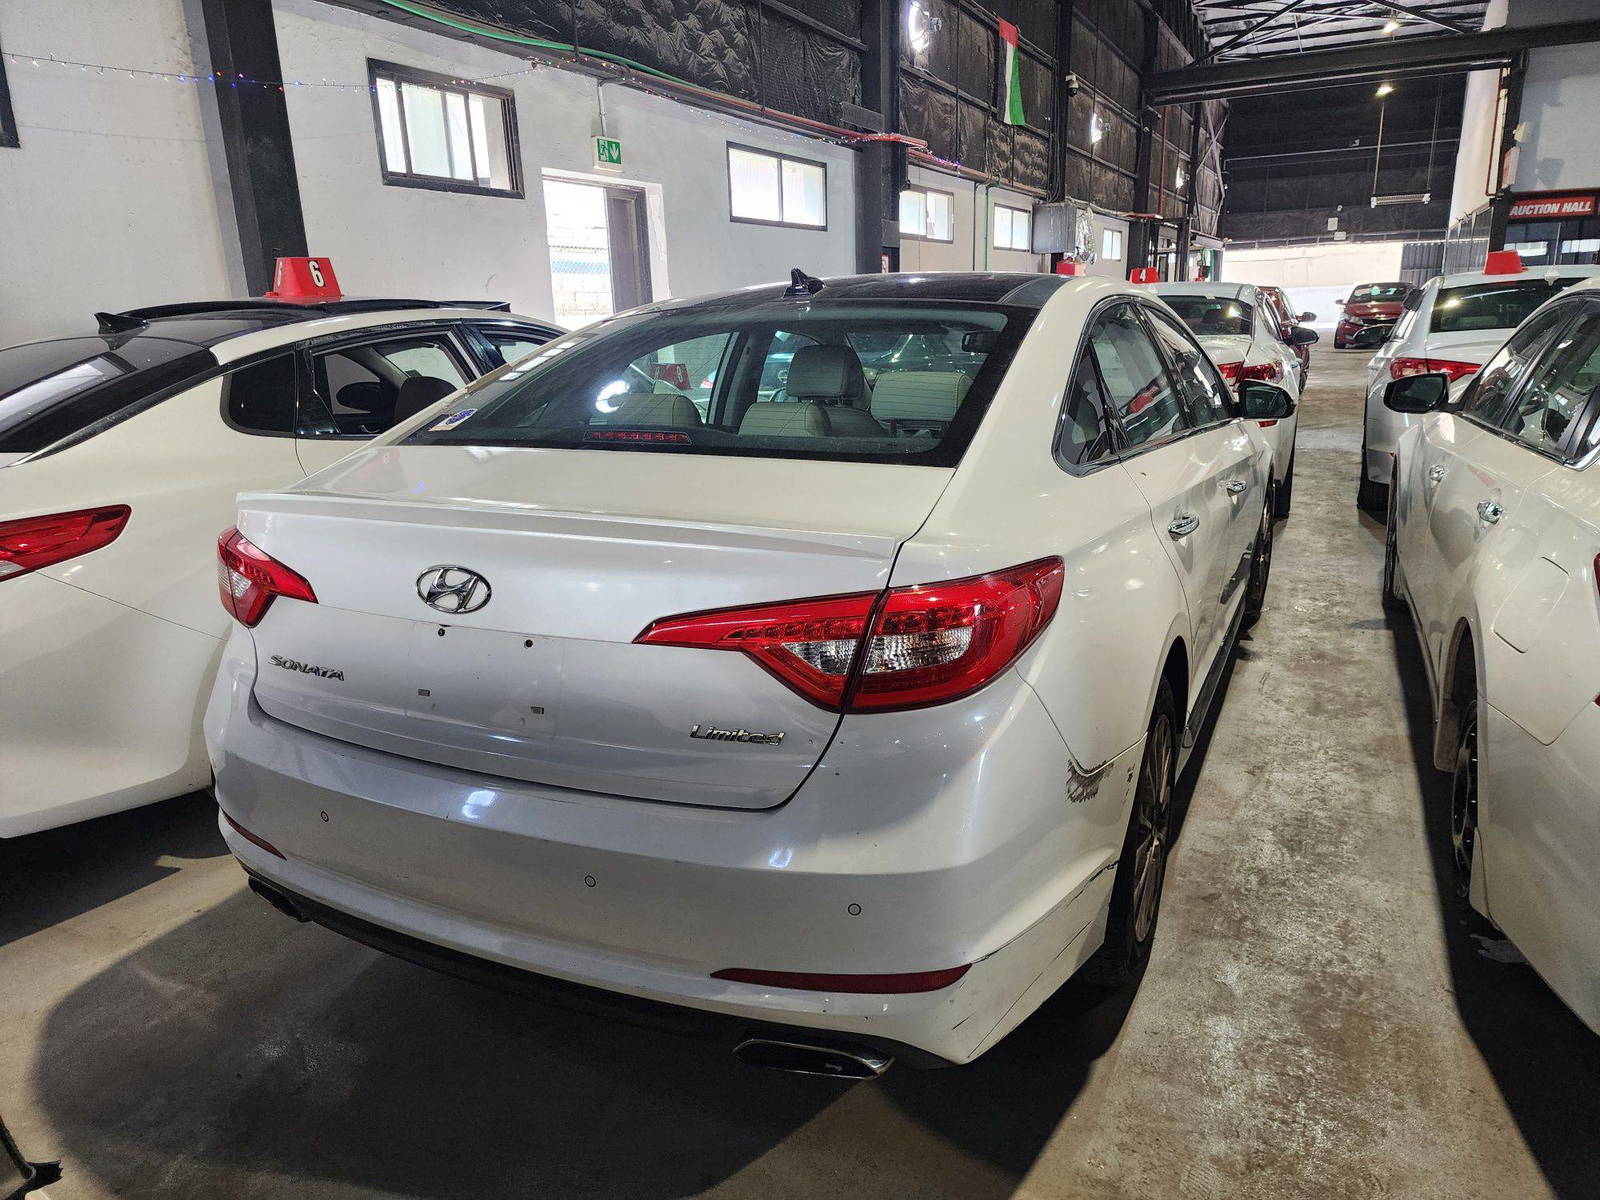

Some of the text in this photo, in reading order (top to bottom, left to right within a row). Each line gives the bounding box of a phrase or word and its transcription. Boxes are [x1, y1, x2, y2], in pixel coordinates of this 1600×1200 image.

[1509, 201, 1591, 216] AUCTION HALL
[308, 260, 325, 288] 6
[268, 654, 345, 681] SONATA
[690, 724, 785, 746] Limited
